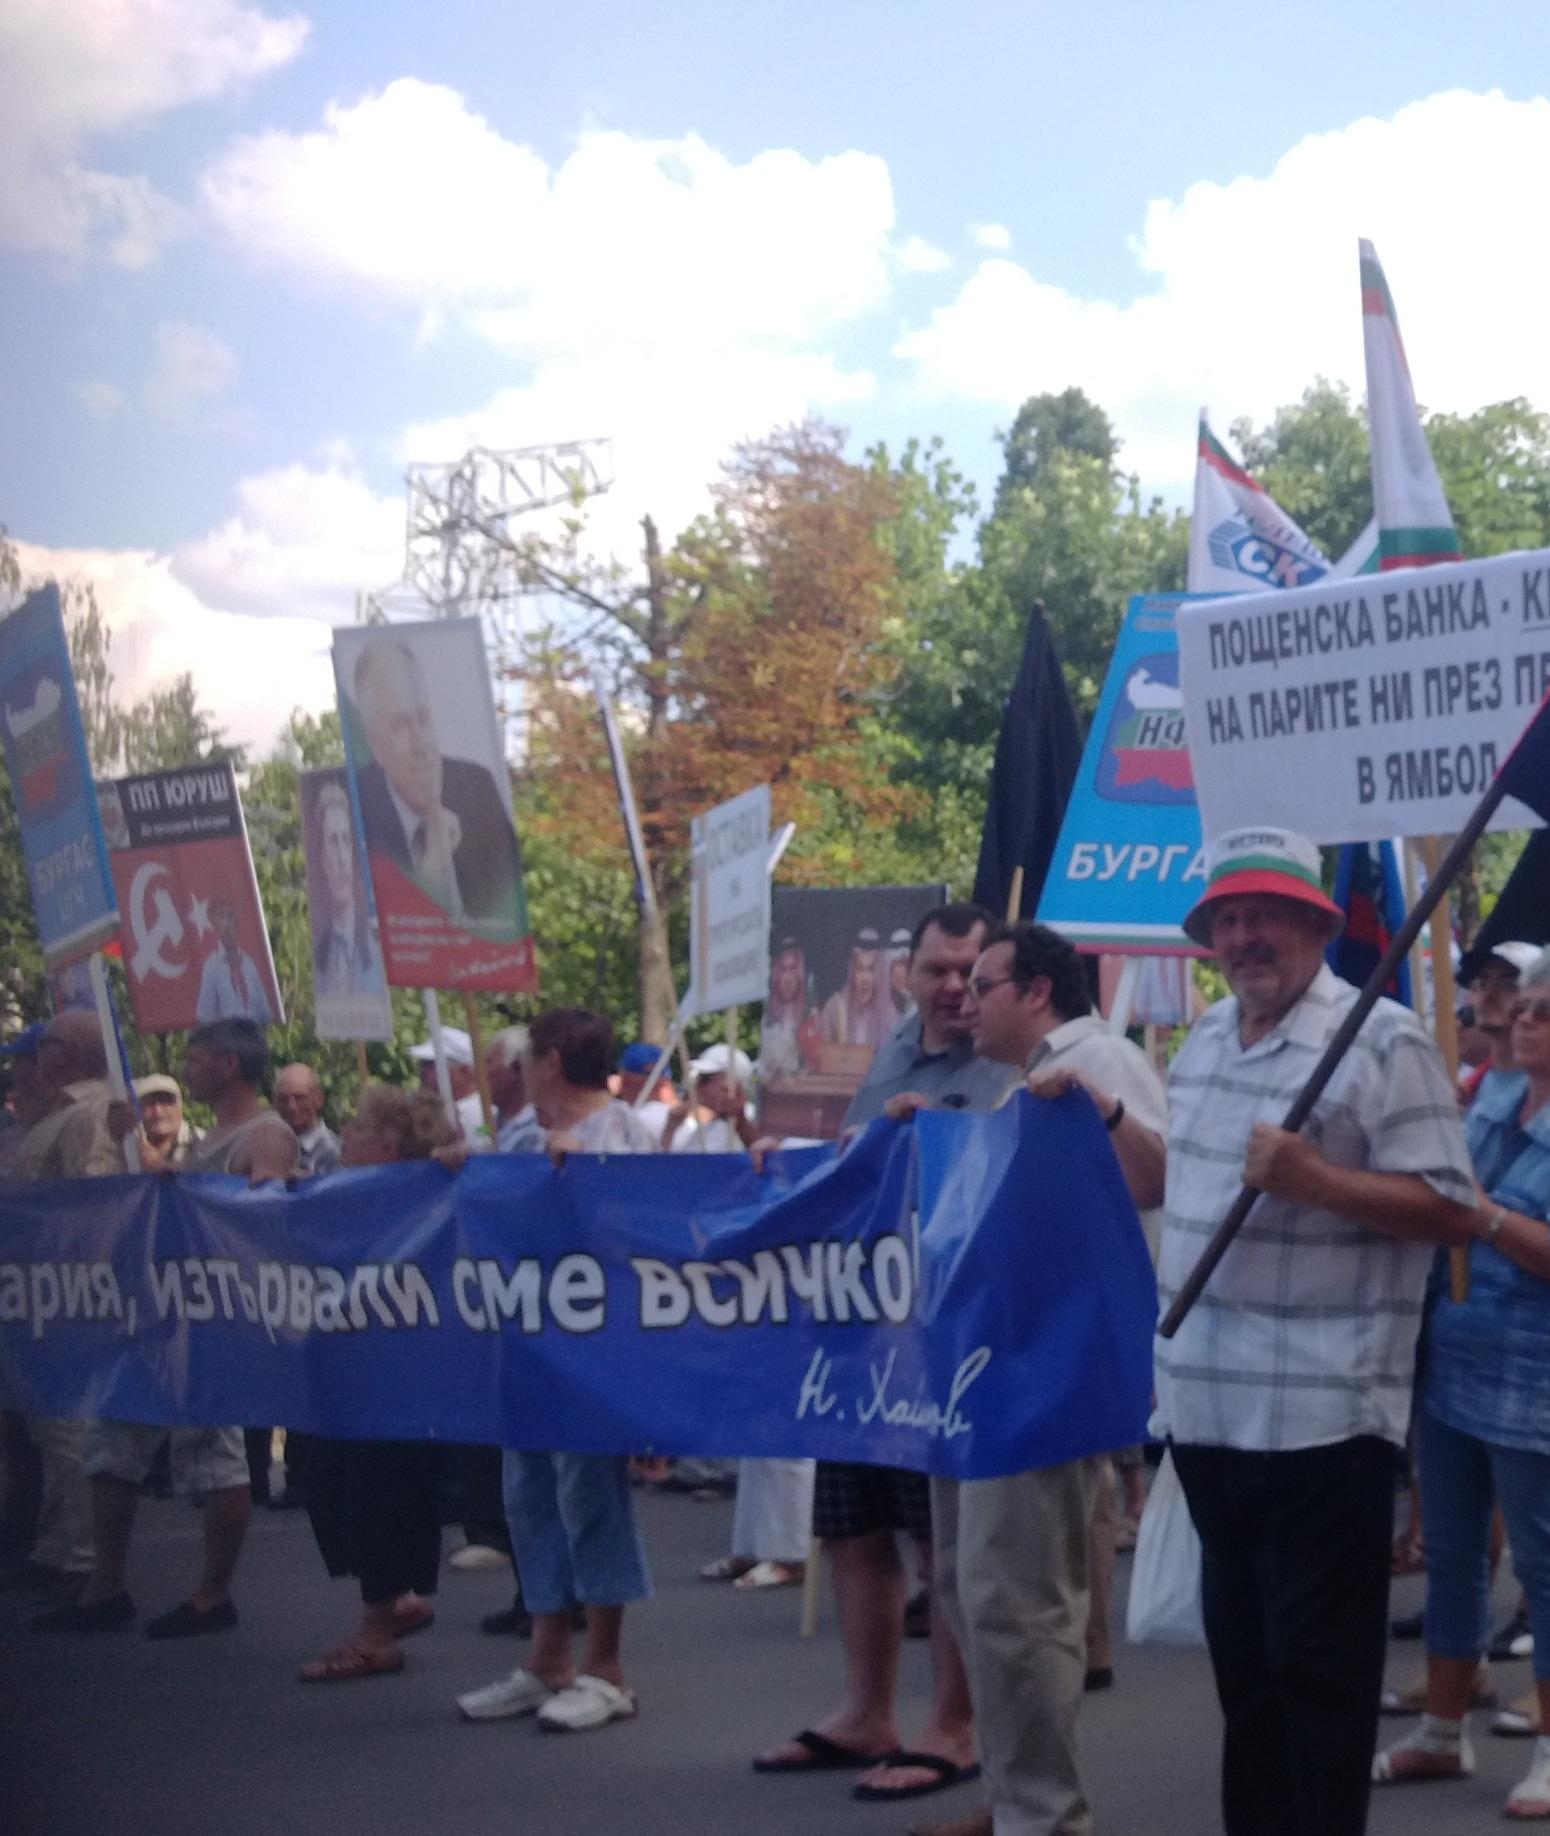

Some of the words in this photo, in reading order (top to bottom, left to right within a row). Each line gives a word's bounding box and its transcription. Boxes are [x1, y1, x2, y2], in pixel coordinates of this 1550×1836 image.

[1208, 596, 1376, 669] ПОЩЕНСКА
[1383, 577, 1490, 643] БАНКА
[1207, 695, 1244, 745] НА
[1249, 678, 1360, 740] ПАРИТЕ
[1369, 671, 1413, 724] НИ
[1424, 657, 1503, 718] ПРЕЗ
[128, 779, 160, 812] ПП
[163, 770, 230, 809] ЮРУШ
[1356, 756, 1376, 804] В
[1385, 741, 1498, 801] ЯМБОЛ
[452, 1252, 606, 1335] сме
